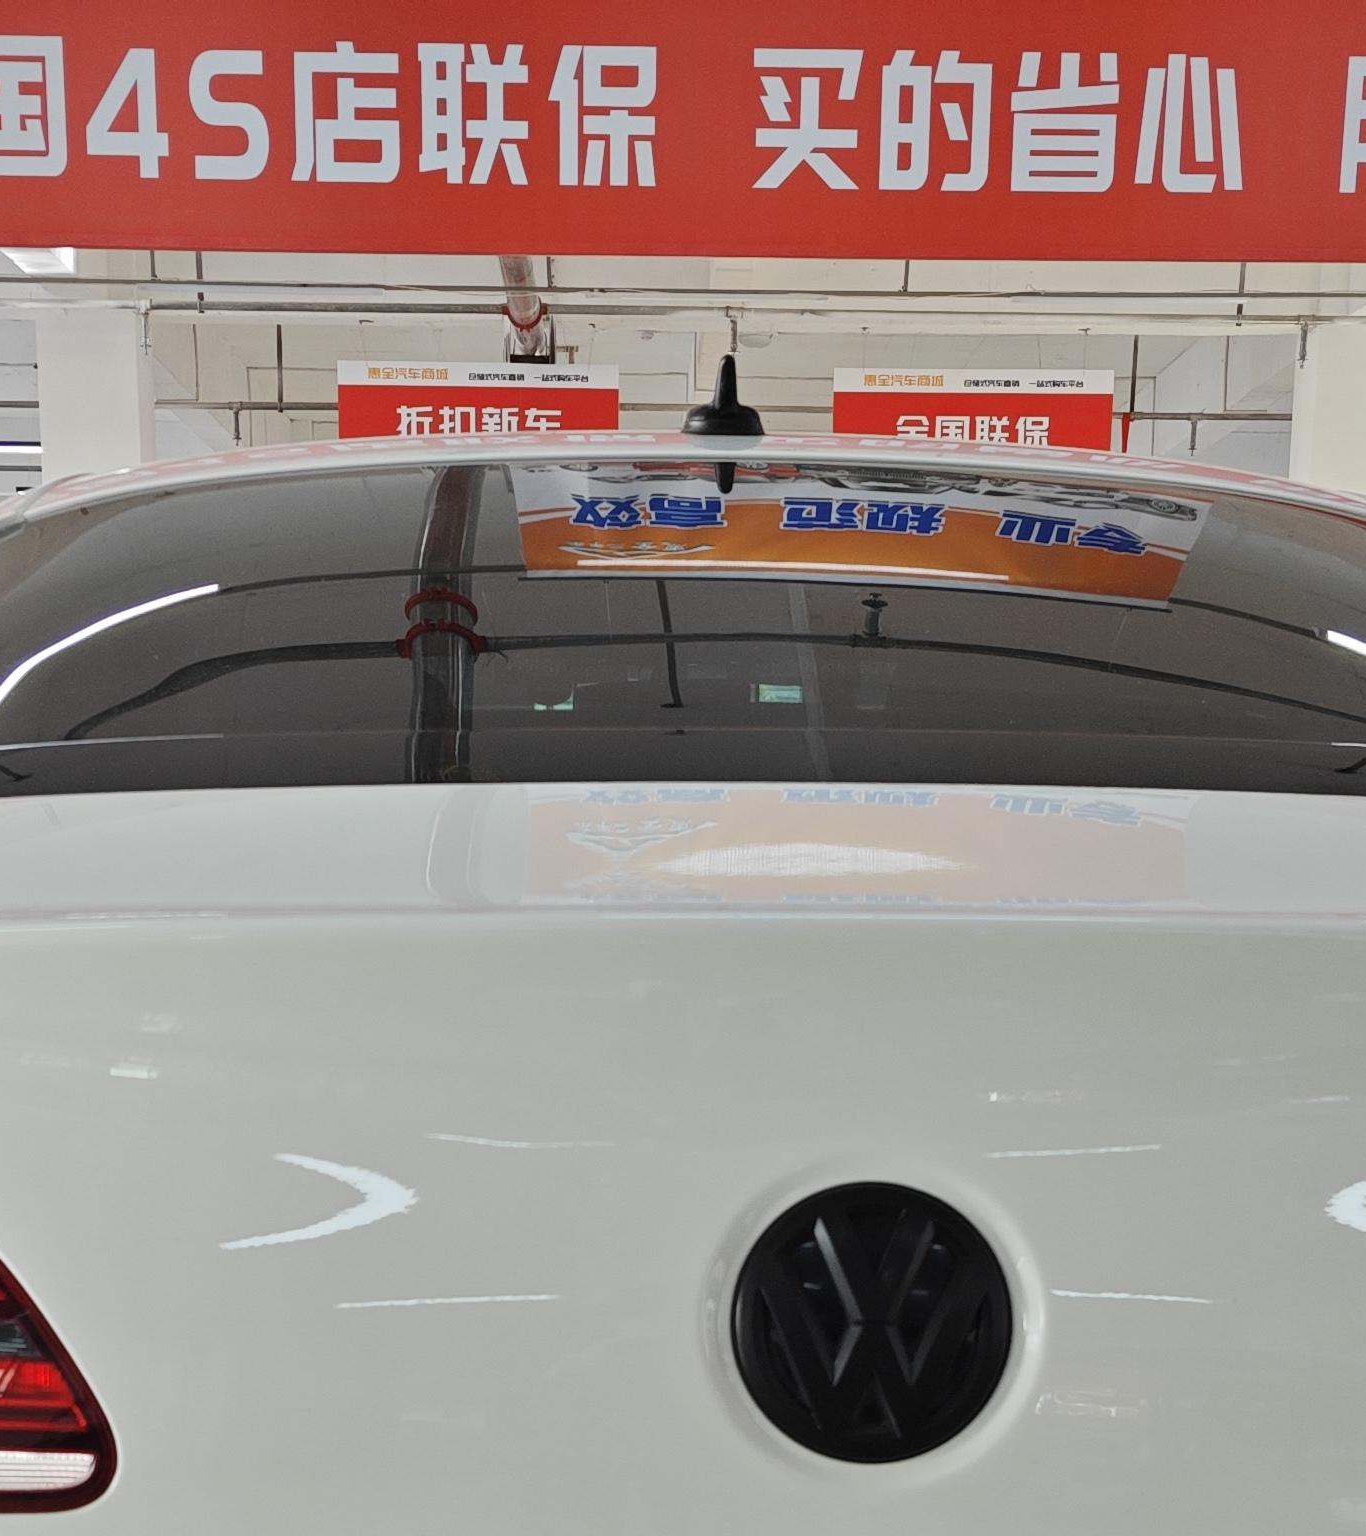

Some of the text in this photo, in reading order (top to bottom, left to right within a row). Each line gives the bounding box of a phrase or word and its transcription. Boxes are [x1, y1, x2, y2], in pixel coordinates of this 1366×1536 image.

[751, 48, 1243, 193] 买的省心
[367, 367, 449, 381] 惠全汽车商城
[863, 374, 945, 388] 惠全汽车商城
[396, 405, 562, 438] 折扣新车
[895, 415, 1051, 447] 全国联保
